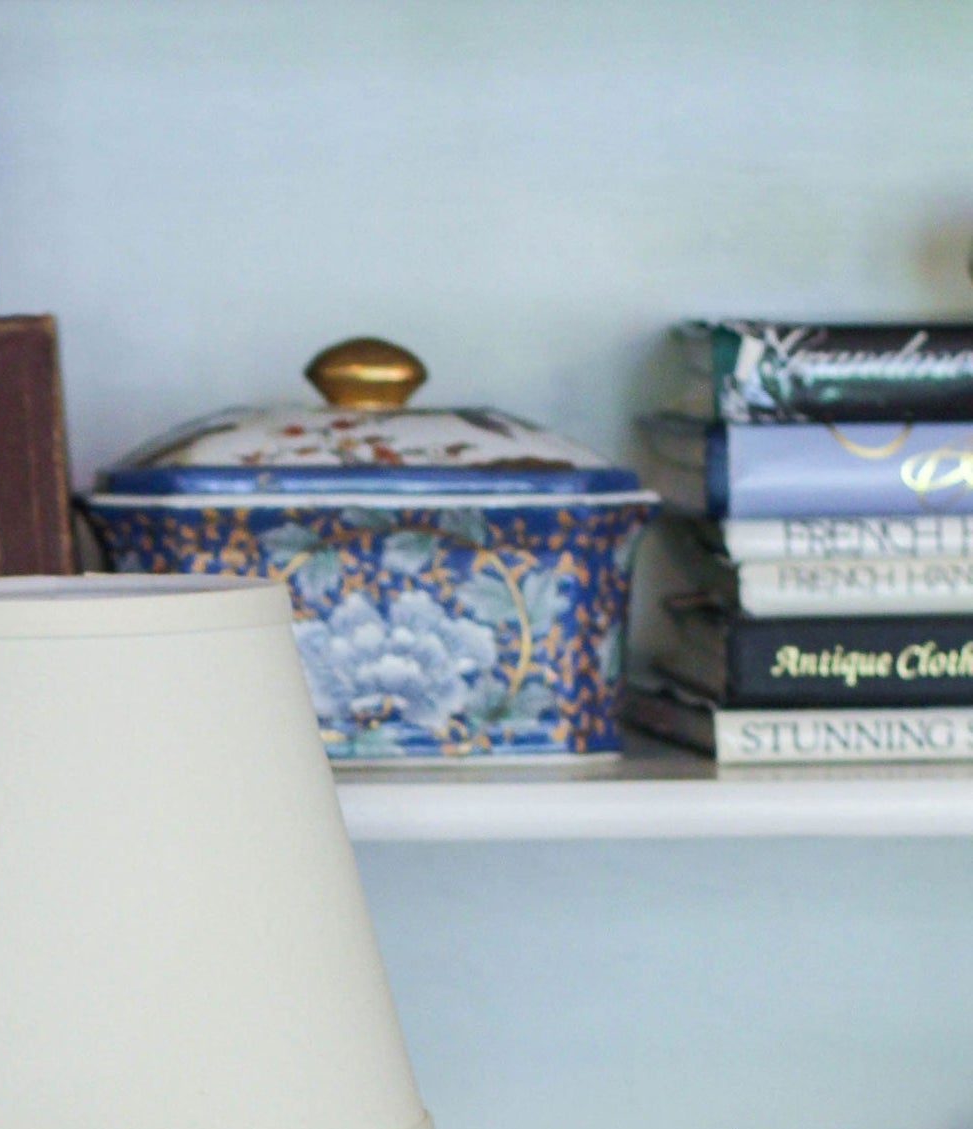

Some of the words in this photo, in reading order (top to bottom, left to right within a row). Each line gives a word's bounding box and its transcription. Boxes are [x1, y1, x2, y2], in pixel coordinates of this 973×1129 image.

[782, 515, 944, 558] FRENCH
[769, 643, 894, 689] Antique
[740, 716, 956, 755] STUNNING
